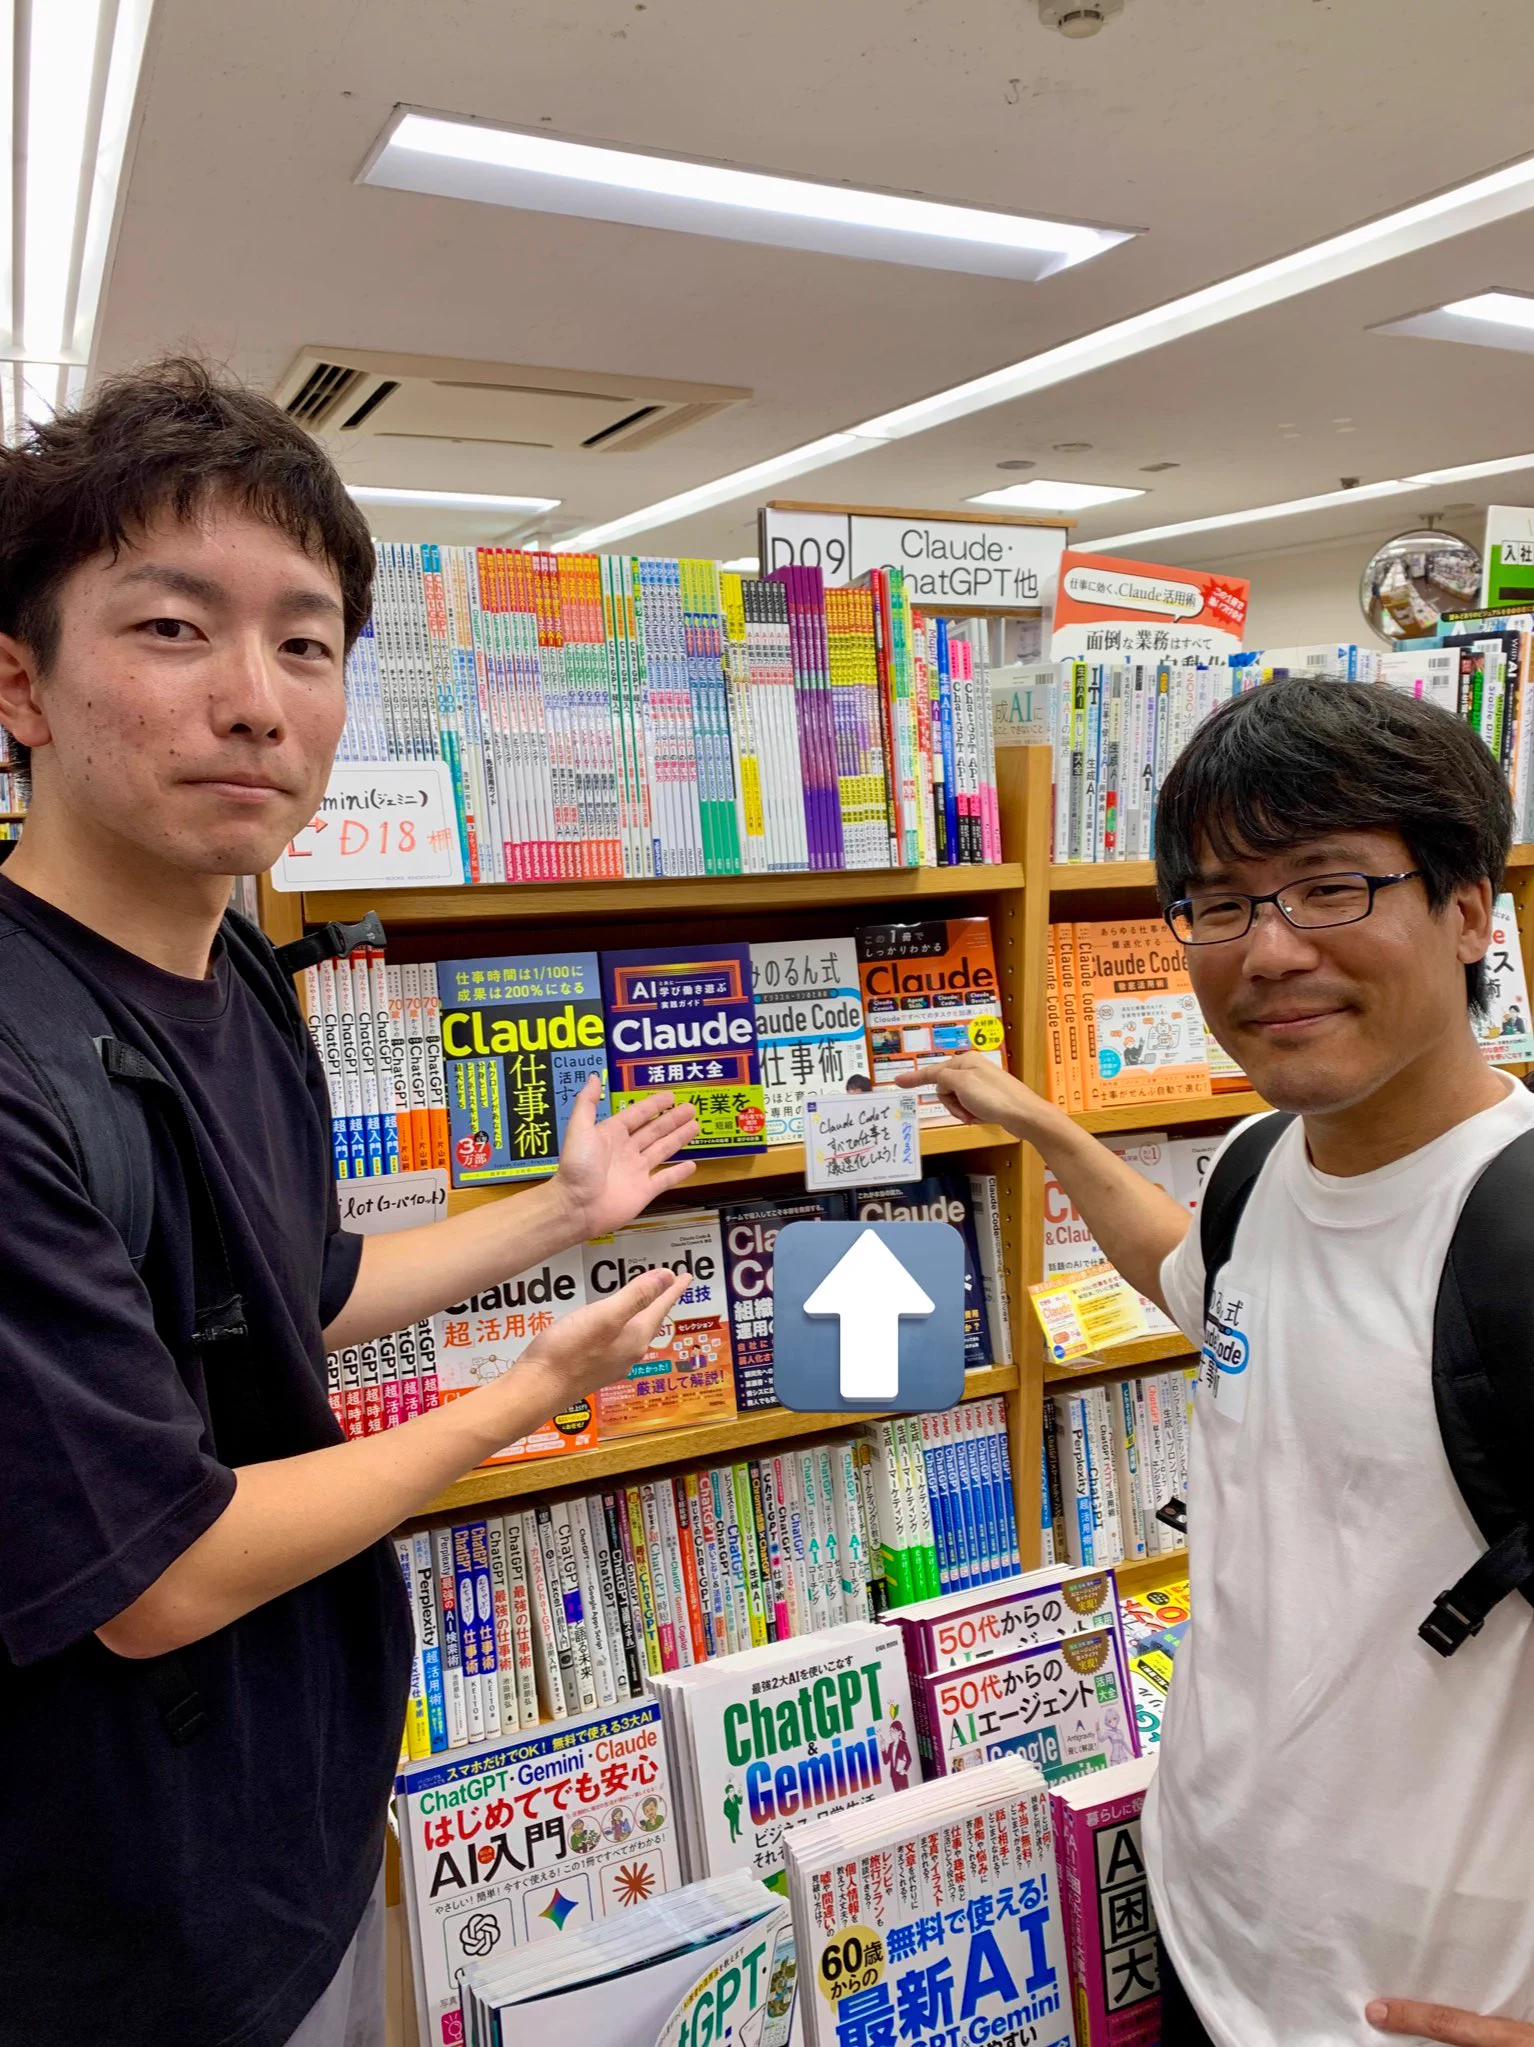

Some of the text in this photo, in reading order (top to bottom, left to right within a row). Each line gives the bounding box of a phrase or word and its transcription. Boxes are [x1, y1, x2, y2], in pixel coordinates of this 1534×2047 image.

[772, 537, 846, 576] D09
[880, 564, 1038, 599] hatGPT他
[316, 789, 428, 811] mini(ジェミニ)
[339, 819, 416, 856] D18
[456, 966, 584, 985] 仕事時間は1/100に
[866, 943, 942, 957] しっかりわかる
[866, 957, 993, 996] Claude
[457, 982, 585, 1002] 成果は200%になる
[632, 981, 656, 999] AI
[1060, 943, 1076, 1024] Claude Code
[442, 1005, 604, 1057] Claude
[612, 1012, 753, 1052] Claude
[757, 1002, 860, 1035] aude Code
[974, 1028, 986, 1046] 6
[325, 1014, 348, 1159] ChatGPT 超入門
[342, 1013, 365, 1157] ChatGPT 超入門
[359, 1012, 382, 1156] ChatGPT 超入門
[410, 1043, 426, 1107] ChatGPT
[427, 1042, 444, 1106] ChatGPT
[554, 1056, 603, 1068] Claude
[648, 1060, 723, 1083] 活用大全
[760, 1037, 844, 1088] 仕事術
[509, 1054, 552, 1158] 仕事術
[820, 1113, 853, 1134] Claude
[859, 1196, 966, 1223] Claude
[988, 1177, 997, 1207] Claude
[677, 1321, 714, 1333] セレクション
[636, 1370, 725, 1396] 厳選して解説!
[1073, 1429, 1086, 1495] Perplexity
[764, 1473, 776, 1542] ChatGPT
[779, 1507, 792, 1562] ChatGPT
[803, 1457, 820, 1565] ChatGPT AI
[820, 1453, 837, 1560] ChatGPT AI
[441, 1537, 450, 1576] Perplexity
[715, 1521, 730, 1577] ChatGPT
[849, 1535, 860, 1560] AI
[454, 1531, 479, 1675] ChatGPT 仕事術
[471, 1526, 496, 1670] ChatGPT 仕事術
[490, 1530, 512, 1672] ChatGPT 最強の仕事術
[509, 1526, 532, 1669] ChatGPT 最強の仕事術
[600, 1550, 616, 1608] ChatGPT
[418, 1567, 442, 1706] Perplexity 超活用術
[938, 1599, 1062, 1656] 50代からの
[752, 1655, 853, 1695] 最強2大AIを使いこなす
[940, 1659, 1063, 1716] 50代からの
[1096, 1673, 1114, 1687] 活用
[1098, 1687, 1117, 1702] 大全
[723, 1661, 883, 1767] ChatGPT
[948, 1680, 1095, 1751] AIエージェント
[420, 1729, 658, 1815] ChatGPT Gemini Claude
[446, 1712, 653, 1781] スマホだけでOK! 無料で使える3大AI
[807, 1742, 818, 1756] &
[424, 1754, 659, 1851] はじめてでも安心
[746, 1727, 882, 1827] Gemini
[429, 1816, 567, 1898] AI入門
[951, 1825, 966, 1901] 仕事や趣味など
[974, 1816, 989, 1884] 愚痴や悩みに
[995, 1808, 1008, 1866] 話し相手に
[476, 1887, 501, 1902] 簡単!
[503, 1867, 561, 1893] 今すぐ使える!
[563, 1833, 666, 1872] この1冊ですべてがわかる!
[845, 1863, 860, 1924] 個人情報を
[869, 1855, 884, 1927] 旅行プランも
[882, 1852, 893, 1896] レシピや
[905, 1842, 918, 1909] 文章を代わりに
[928, 1832, 943, 1907] 写真やイラスト
[820, 1871, 836, 1937] 嘘や間違いの
[885, 1873, 1049, 1965] 無料で使える!
[822, 1937, 884, 1981] 60歳
[830, 1968, 879, 2000] からの
[968, 1983, 1061, 2044] Gemini
